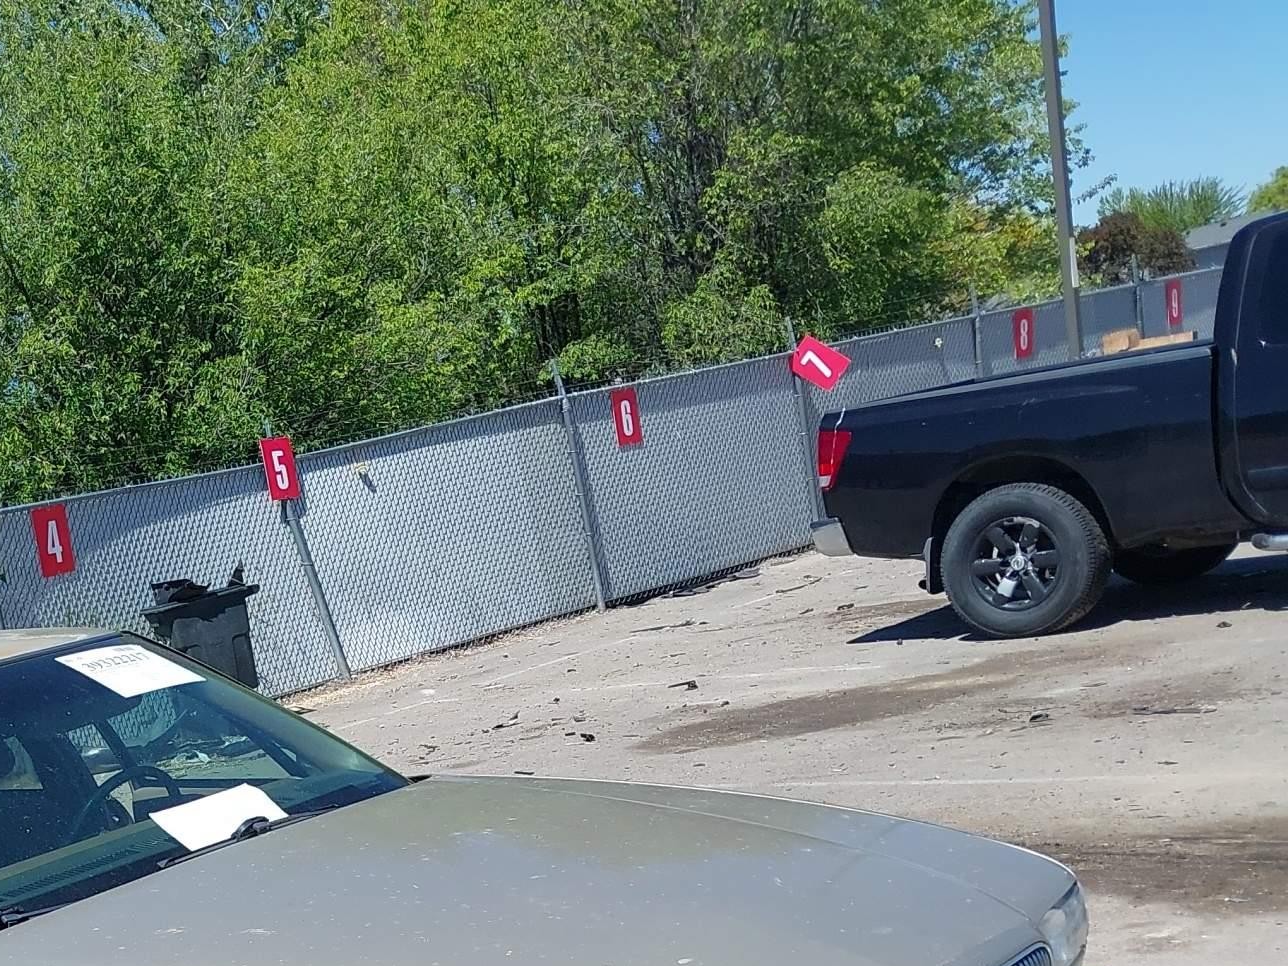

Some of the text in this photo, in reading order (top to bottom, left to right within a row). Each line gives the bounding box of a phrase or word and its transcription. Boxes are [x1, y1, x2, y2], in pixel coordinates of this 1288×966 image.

[1019, 319, 1029, 350] 8
[800, 350, 832, 378] 7
[620, 399, 635, 436] 6
[270, 449, 289, 490] 5
[46, 519, 64, 563] 4
